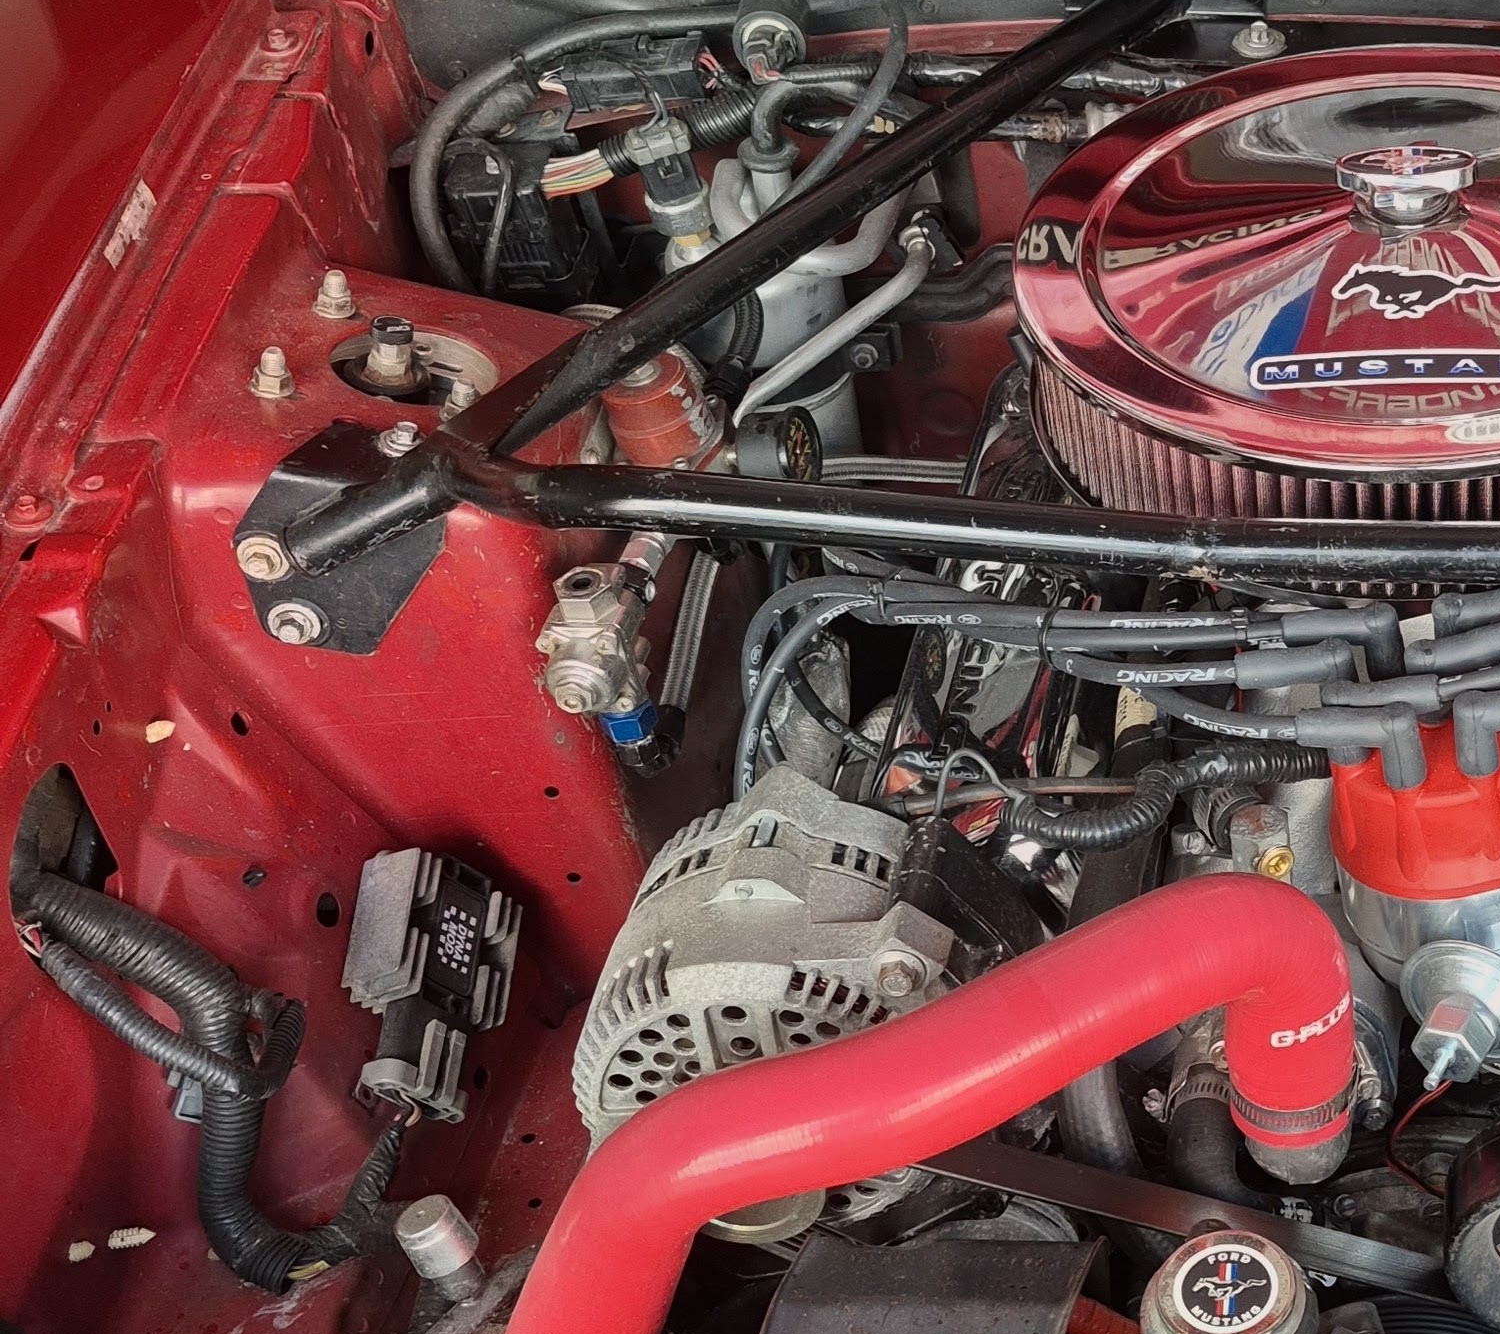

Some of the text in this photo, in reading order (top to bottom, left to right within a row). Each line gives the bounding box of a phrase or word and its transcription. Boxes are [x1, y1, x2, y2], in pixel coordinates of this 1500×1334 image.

[1117, 668, 1216, 685] RACING
[1183, 712, 1271, 741] RACING
[444, 920, 458, 955] MOD
[457, 923, 470, 963] DYNA
[1207, 1251, 1252, 1265] FORD
[1189, 1304, 1262, 1327] MUSTANG
